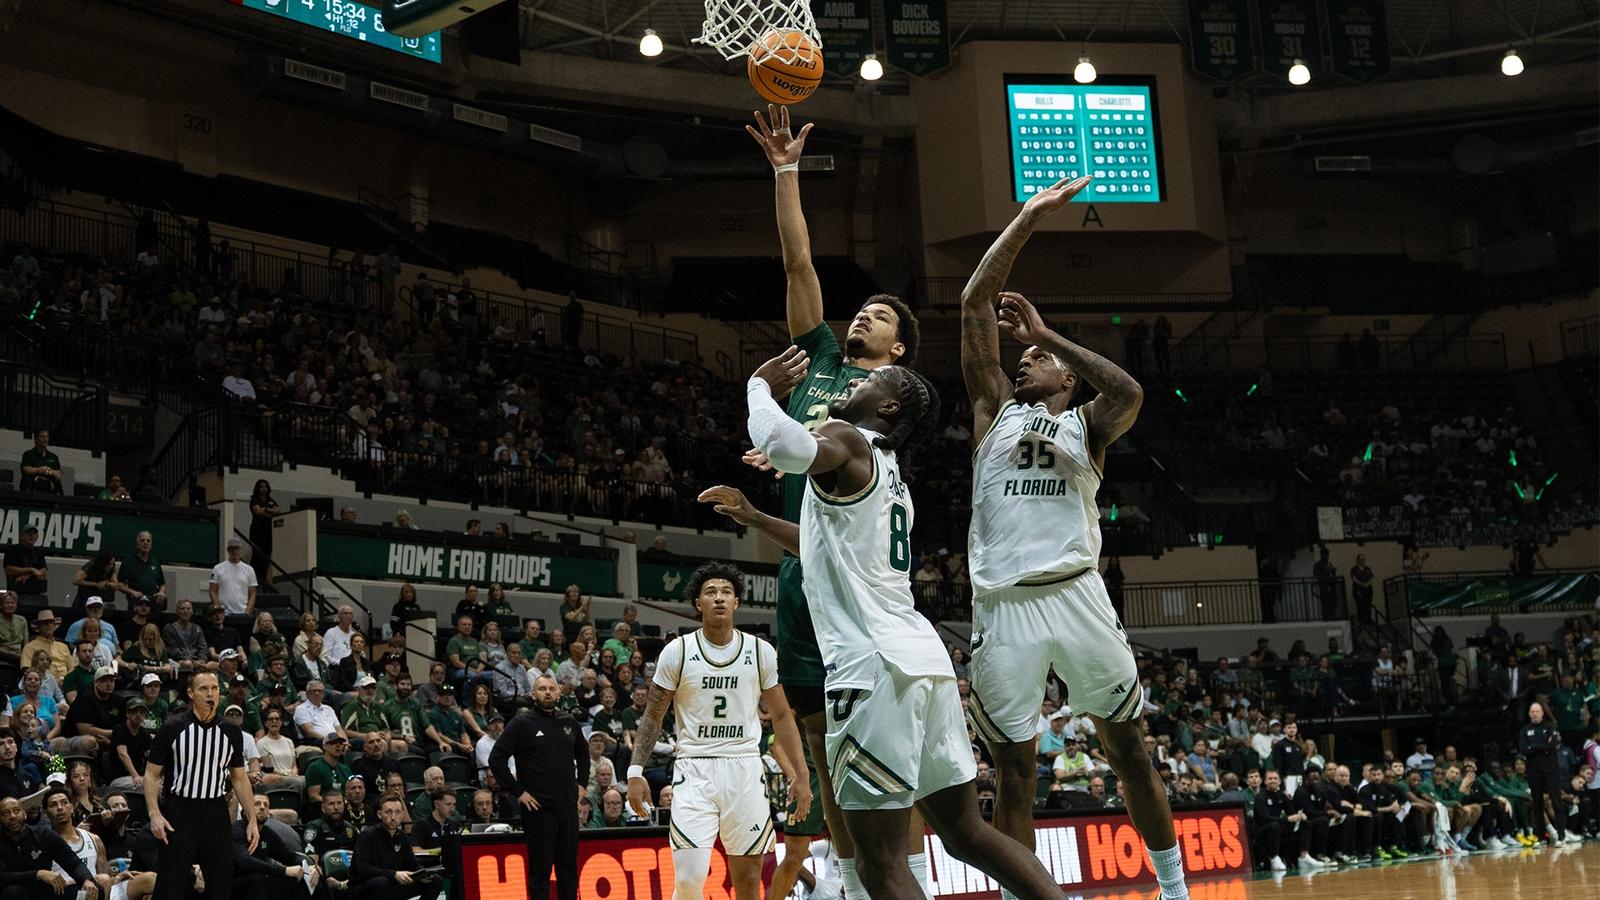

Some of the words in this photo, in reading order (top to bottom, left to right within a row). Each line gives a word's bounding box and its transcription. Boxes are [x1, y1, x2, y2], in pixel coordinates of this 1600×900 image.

[324, 0, 367, 22] 15:34
[824, 3, 856, 17] AMIR
[902, 4, 930, 18] DICK
[892, 20, 941, 35] BOWERS
[1209, 36, 1236, 56] 30
[184, 112, 211, 133] 320
[1082, 205, 1104, 228] A
[107, 413, 145, 436] 214
[1017, 440, 1055, 469] 35
[1003, 479, 1067, 496] FLORIDA
[28, 511, 103, 551] BAY'S
[889, 501, 910, 573] 8
[387, 543, 445, 578] HOME
[449, 549, 487, 581] FOR
[490, 552, 551, 586] HOOPS
[743, 574, 779, 602] FWB
[702, 676, 738, 689] SOUTH
[714, 696, 727, 718] 2
[698, 725, 744, 738] FLORIDA
